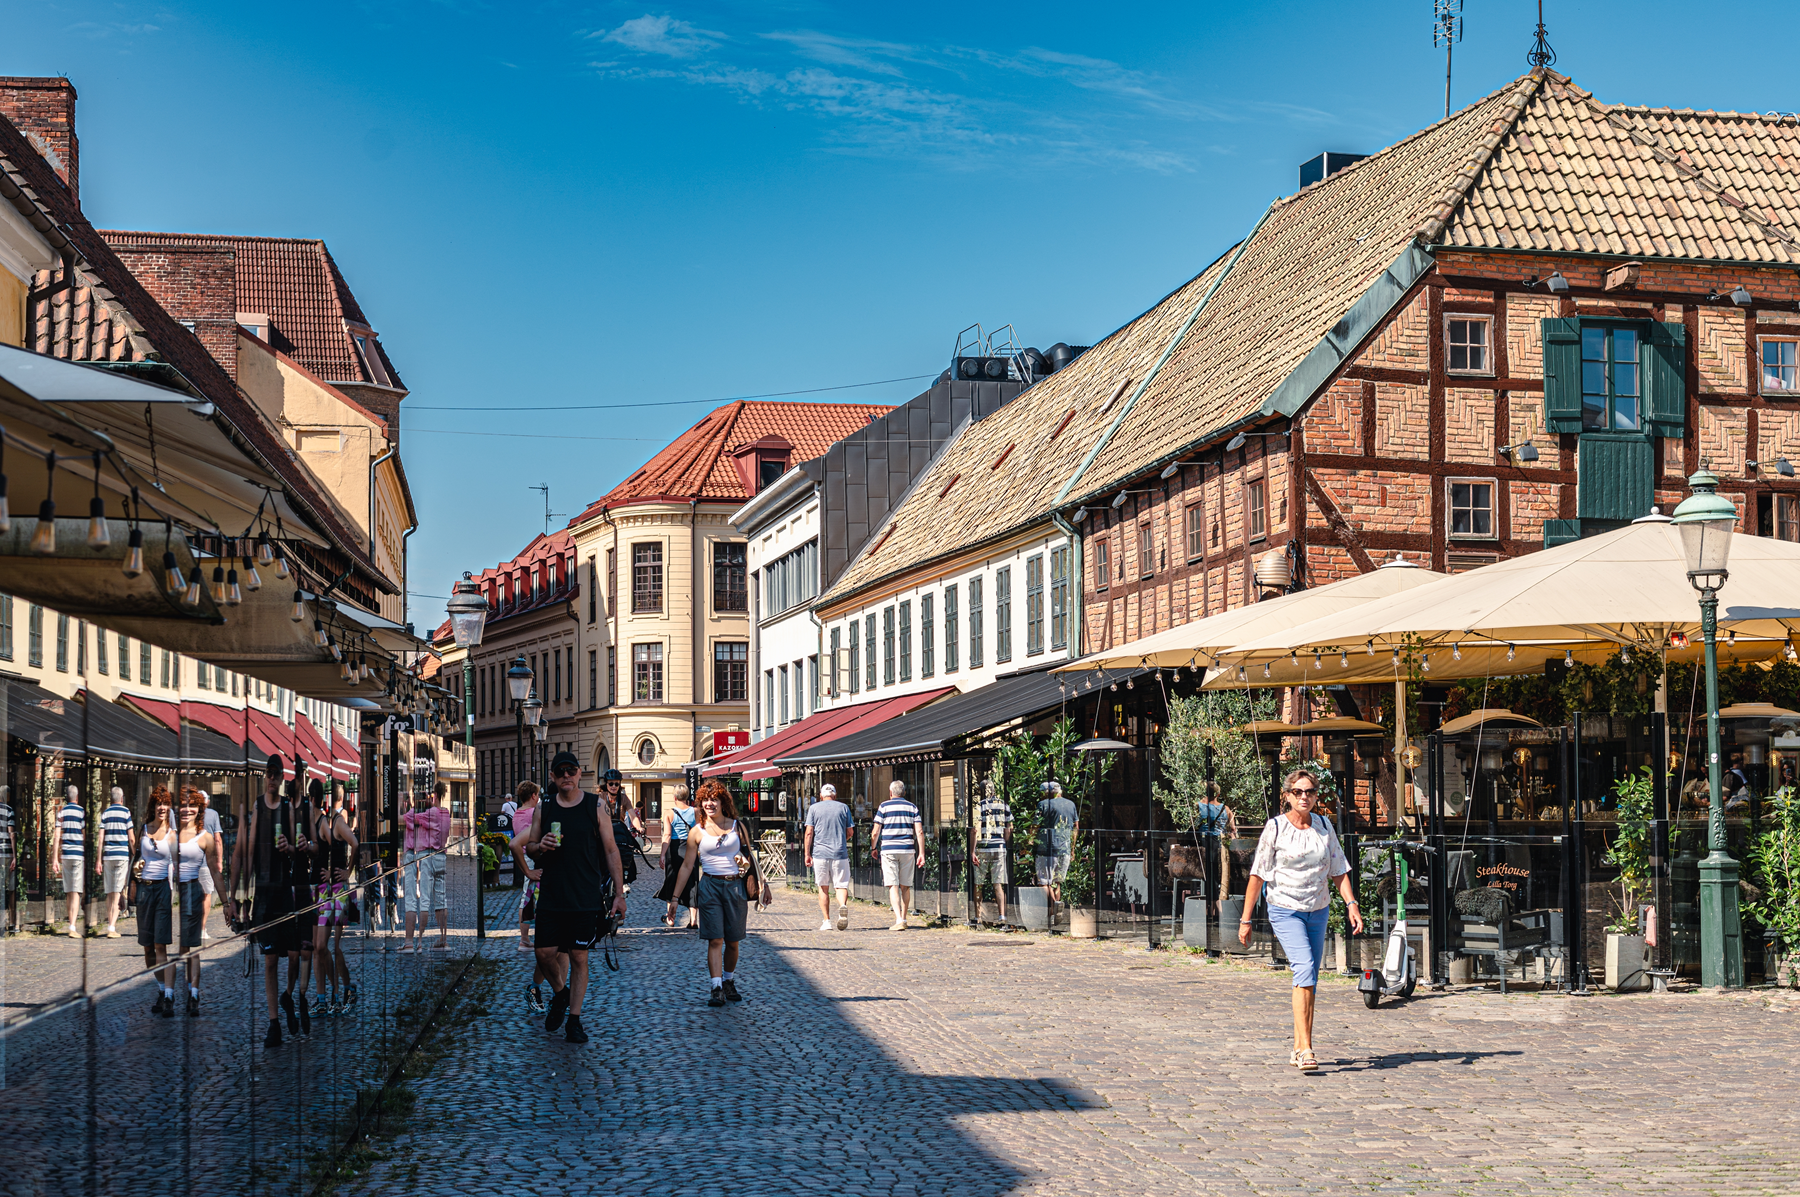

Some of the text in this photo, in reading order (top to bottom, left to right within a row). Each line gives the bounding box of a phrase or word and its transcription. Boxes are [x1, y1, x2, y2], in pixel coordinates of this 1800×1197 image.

[1475, 862, 1530, 878] Steakhouse
[1486, 880, 1518, 891] Lilla Torg
